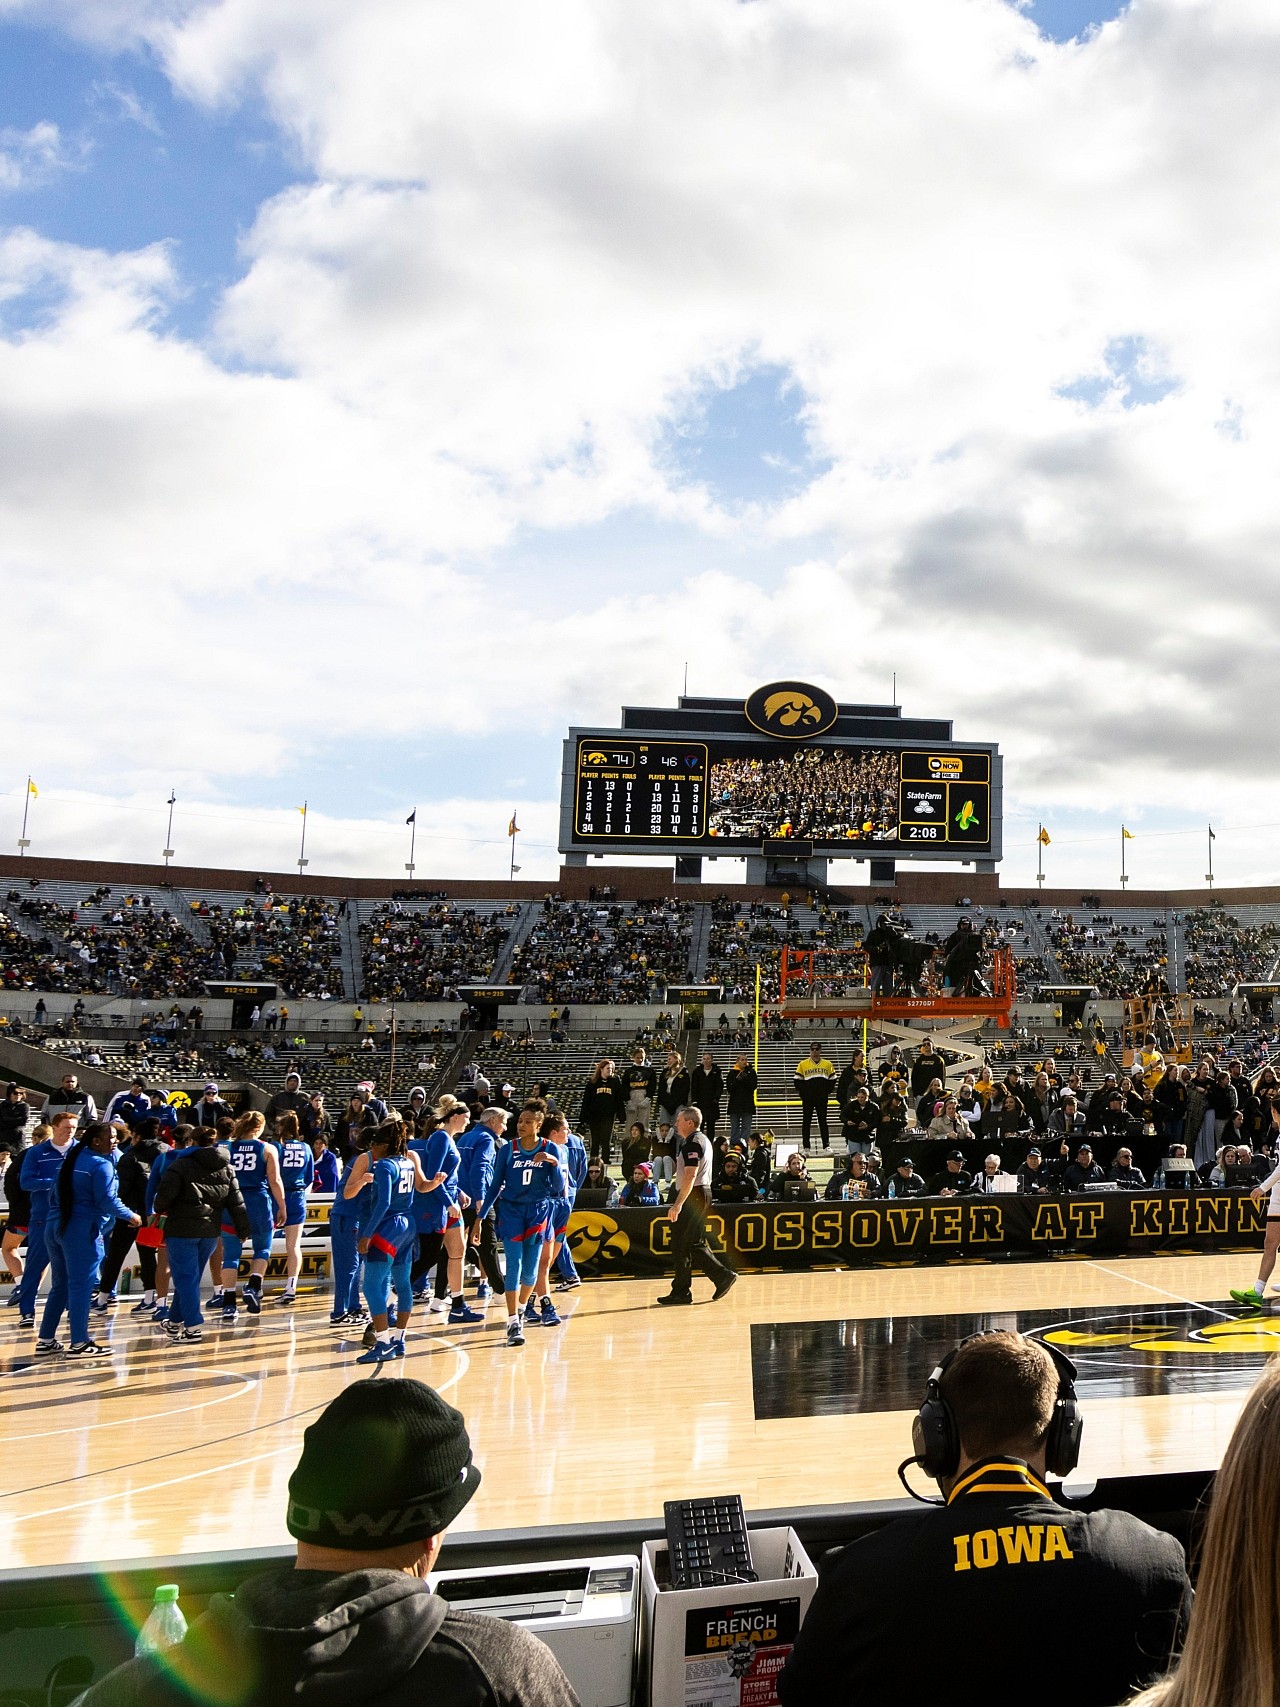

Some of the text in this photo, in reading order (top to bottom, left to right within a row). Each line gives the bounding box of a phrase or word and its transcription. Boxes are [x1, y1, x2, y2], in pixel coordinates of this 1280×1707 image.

[612, 754, 678, 766] 74 3 46
[587, 781, 698, 792] 1 13 0 0 1 3
[587, 792, 698, 803] 2 3 1 13 11 3
[586, 802, 698, 814] 3 2 2 20 0 0
[585, 813, 697, 824] 4 1 1 23 10 1
[582, 824, 697, 835] 34 0 0 33 4 4
[910, 827, 937, 838] 2:08
[232, 1153, 257, 1171] 33
[283, 1150, 305, 1168] 25
[398, 1170, 414, 1193] 20
[522, 1169, 532, 1185] 0
[650, 1204, 1004, 1255] CROSSOVER
[1032, 1202, 1104, 1240] AT
[289, 1501, 441, 1536] OWA
[953, 1525, 1074, 1572] IOWA
[706, 1614, 777, 1636] FRENCH
[706, 1628, 777, 1648] BREAD
[756, 1657, 785, 1668] JIMM
[744, 1681, 770, 1689] STORE
[743, 1693, 767, 1703] FREAKY
